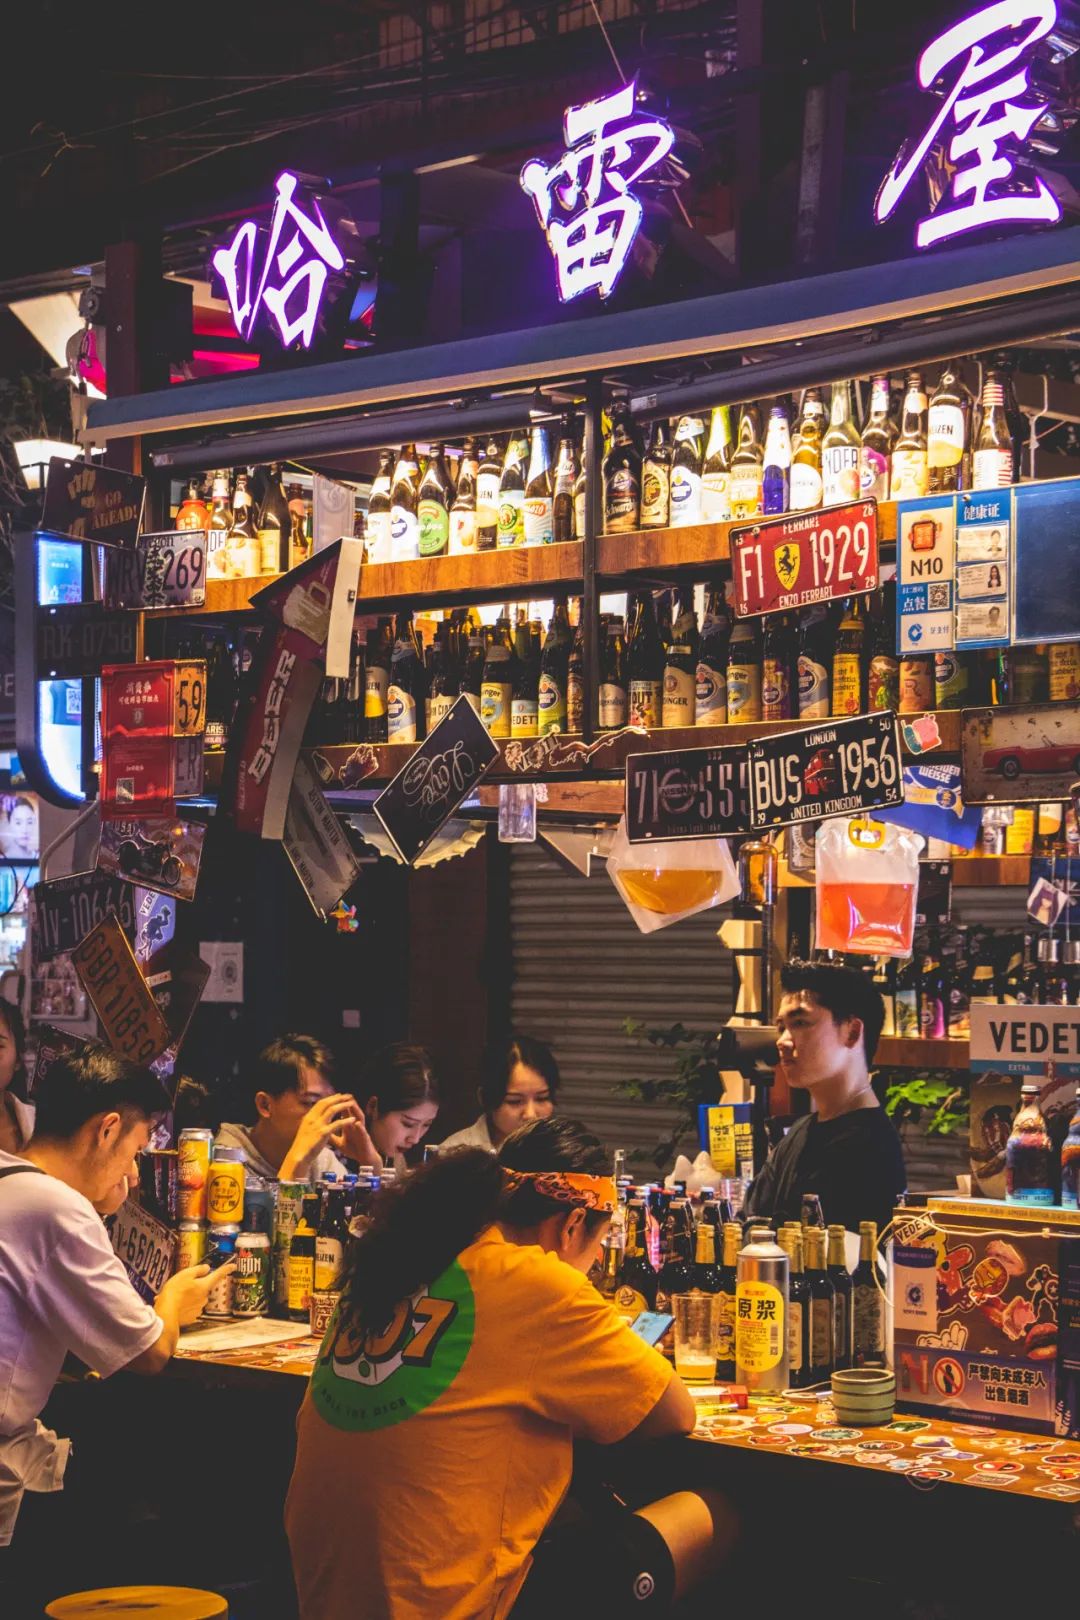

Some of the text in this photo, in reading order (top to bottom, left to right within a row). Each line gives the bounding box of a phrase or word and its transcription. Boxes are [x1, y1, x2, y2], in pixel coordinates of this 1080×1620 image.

[964, 503, 1000, 521] 健康证
[163, 547, 204, 591] 269
[740, 521, 869, 602] F1 1929
[911, 557, 943, 577] N10
[779, 585, 833, 608] ENZO FERRARI
[902, 597, 926, 612] 点餐
[178, 680, 203, 729] 59
[248, 649, 296, 785] BEER
[805, 729, 837, 748] LONDON
[754, 736, 896, 811] BUS 1956
[919, 767, 952, 784] WEISSE
[791, 795, 862, 820] UNITED KINGDOM
[738, 1298, 776, 1321] 原浆
[967, 1362, 1046, 1388] 严禁向未成年人
[984, 1385, 1029, 1406] 出售烟酒
